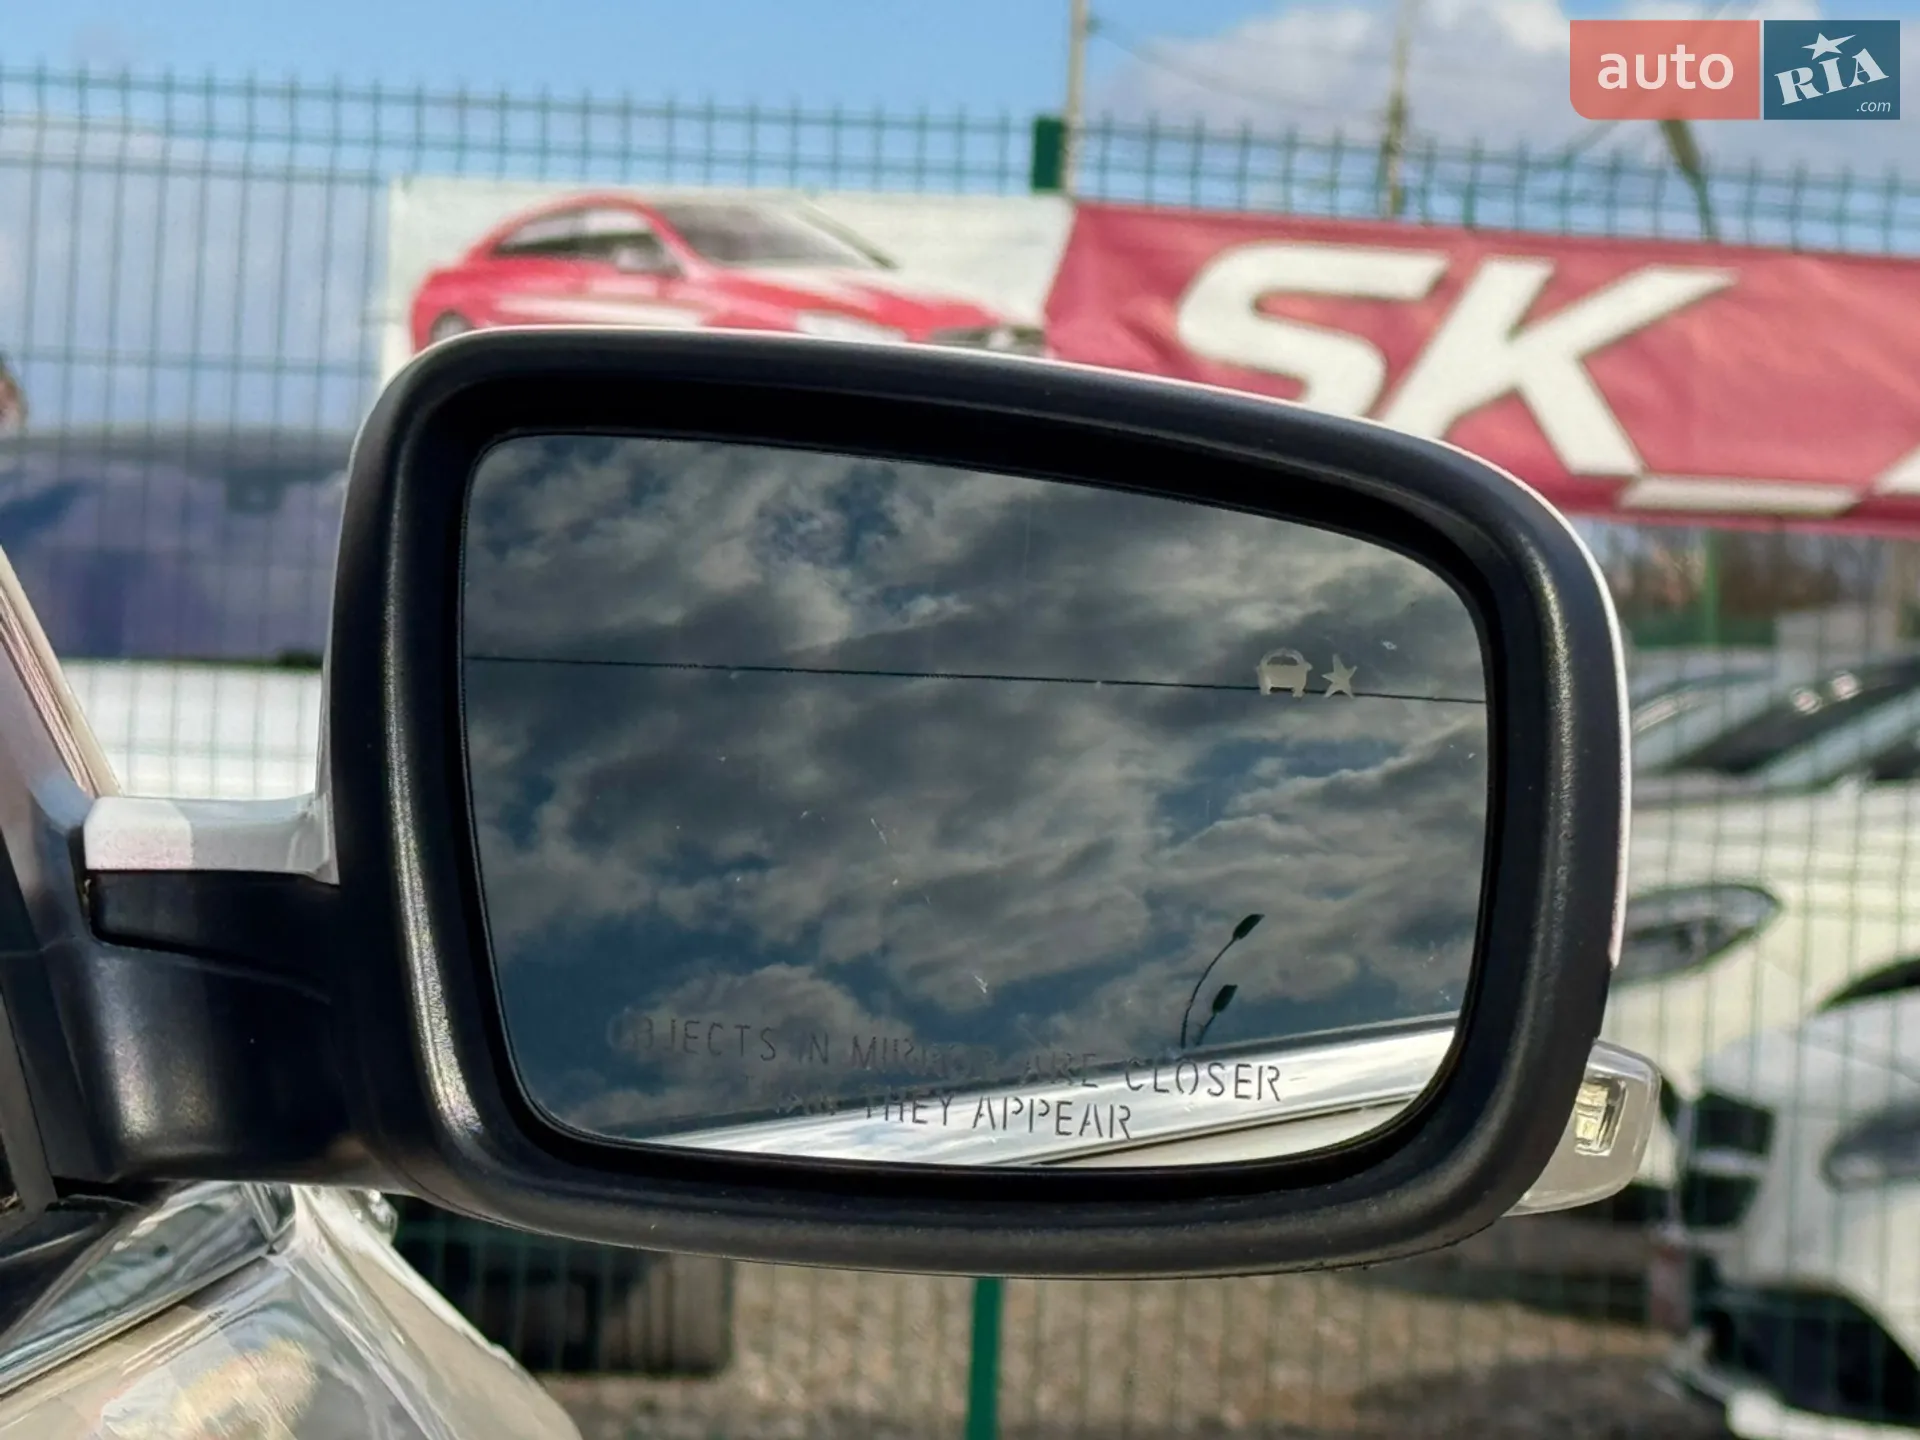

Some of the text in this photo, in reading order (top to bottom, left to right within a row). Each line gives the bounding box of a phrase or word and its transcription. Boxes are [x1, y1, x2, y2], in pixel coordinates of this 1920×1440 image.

[1176, 240, 1738, 476] SK
[1125, 1058, 1281, 1101] CLOSER
[973, 1096, 1131, 1139] APPEAR
